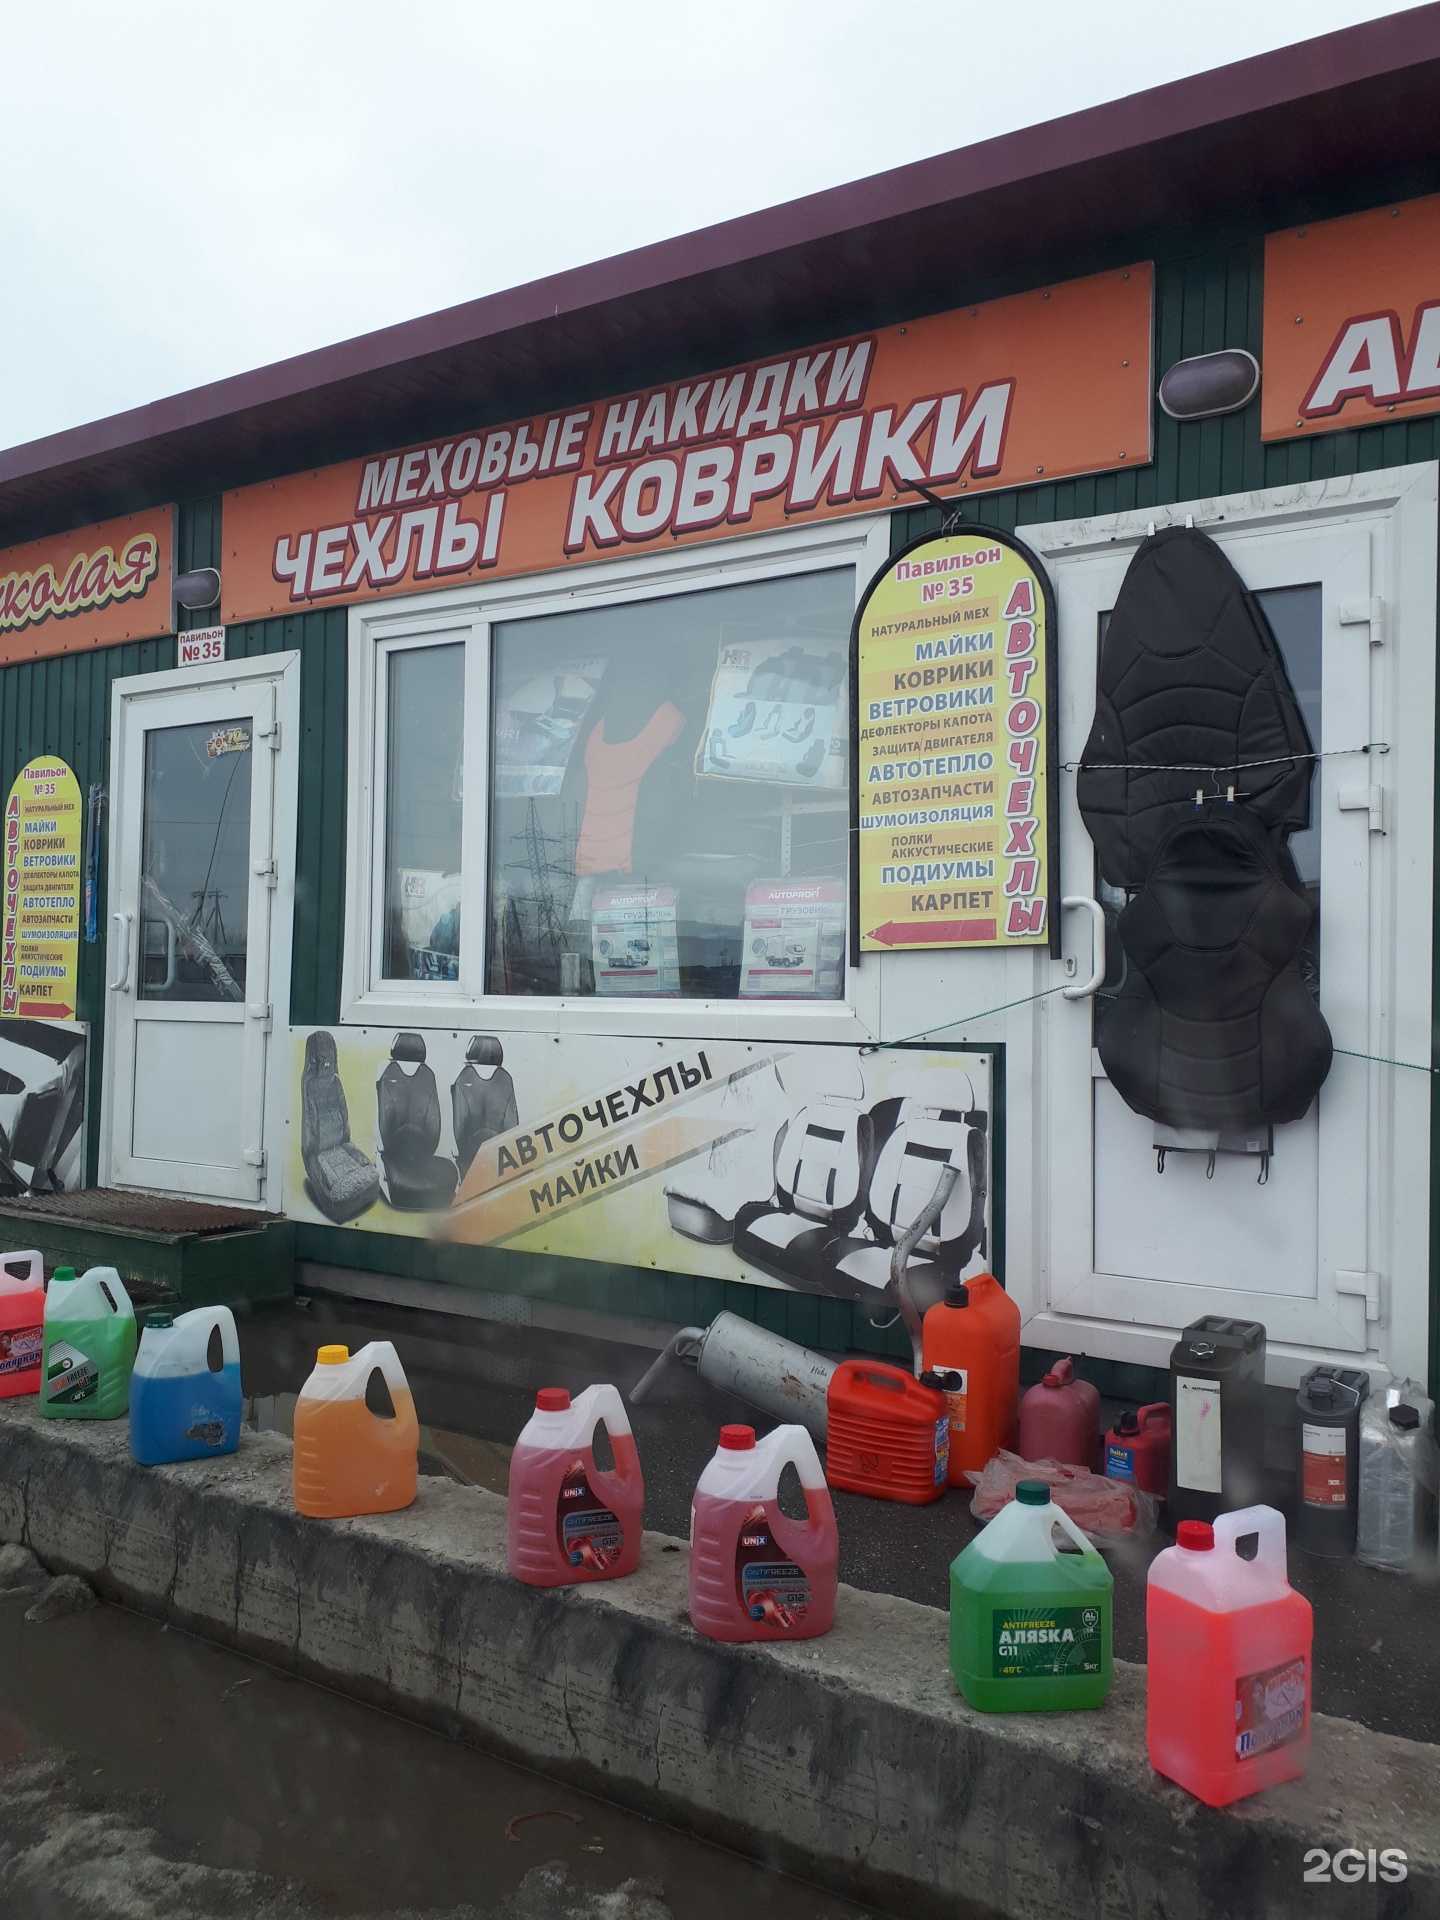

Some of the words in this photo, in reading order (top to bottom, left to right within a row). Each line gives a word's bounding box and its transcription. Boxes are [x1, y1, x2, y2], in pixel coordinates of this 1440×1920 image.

[358, 410, 592, 514] МЕХОВЫЕ
[599, 340, 874, 461] НАКИДКИ
[274, 490, 503, 600] ЧЕХЛЫ
[566, 380, 1013, 550] КОВРИКИ
[897, 547, 1001, 580] Павильон
[0, 536, 157, 624] колая
[949, 577, 973, 596] 35
[871, 611, 961, 637] НАТУРАЛЬНЫЙ
[964, 608, 989, 621] МЕХ
[180, 629, 224, 644] ПАВИЛЬОН
[915, 632, 993, 661] МАЙКИ
[894, 659, 993, 690] КОВРИКИ
[869, 687, 993, 720] ВЕТРОВИКИ
[861, 719, 941, 741] ДЕФЛЕКТОРЫ
[943, 712, 993, 732] КАПОТА
[872, 740, 921, 757] ЗАЩИТА
[924, 731, 993, 751] ДВИГАТЕЛЯ
[868, 752, 993, 782] АВТОТЕПЛО
[1005, 578, 1047, 936] АВТОЧЕХЛЫ
[24, 768, 66, 779] Павильон
[45, 784, 55, 794] 35
[872, 781, 993, 805] АВТОЗАПЧАСТИ
[24, 820, 57, 833] МАЙКИ
[861, 805, 993, 829] ШУМОИЗОЛЯЦИЯ
[24, 838, 65, 850] КОВРИКИ
[891, 833, 933, 847] ПОЛКИ
[891, 841, 993, 859] АККУСТИЧЕСКИЕ
[24, 855, 76, 867] ВЕТРОВИКИ
[880, 860, 994, 885] ПОДИУМЫ
[2, 795, 20, 1014] АВТОЧЕХЛЫ
[23, 896, 75, 908] АВТОТЕПЛО
[911, 891, 993, 912] КАРПЕТ
[22, 914, 73, 924] АВТОЗАПЧАСТИ
[21, 930, 79, 939] ШУМОИЗОЛЯЦИЯ
[20, 965, 66, 978] ПОДИУМЫ
[20, 984, 53, 997] КАРПЕТ
[497, 1050, 713, 1177] АВТОЧЕХЛЫ
[529, 1143, 640, 1214] МАЙКИ
[1002, 1619, 1056, 1630] ANTIFREEZE
[998, 1645, 1018, 1656] G11
